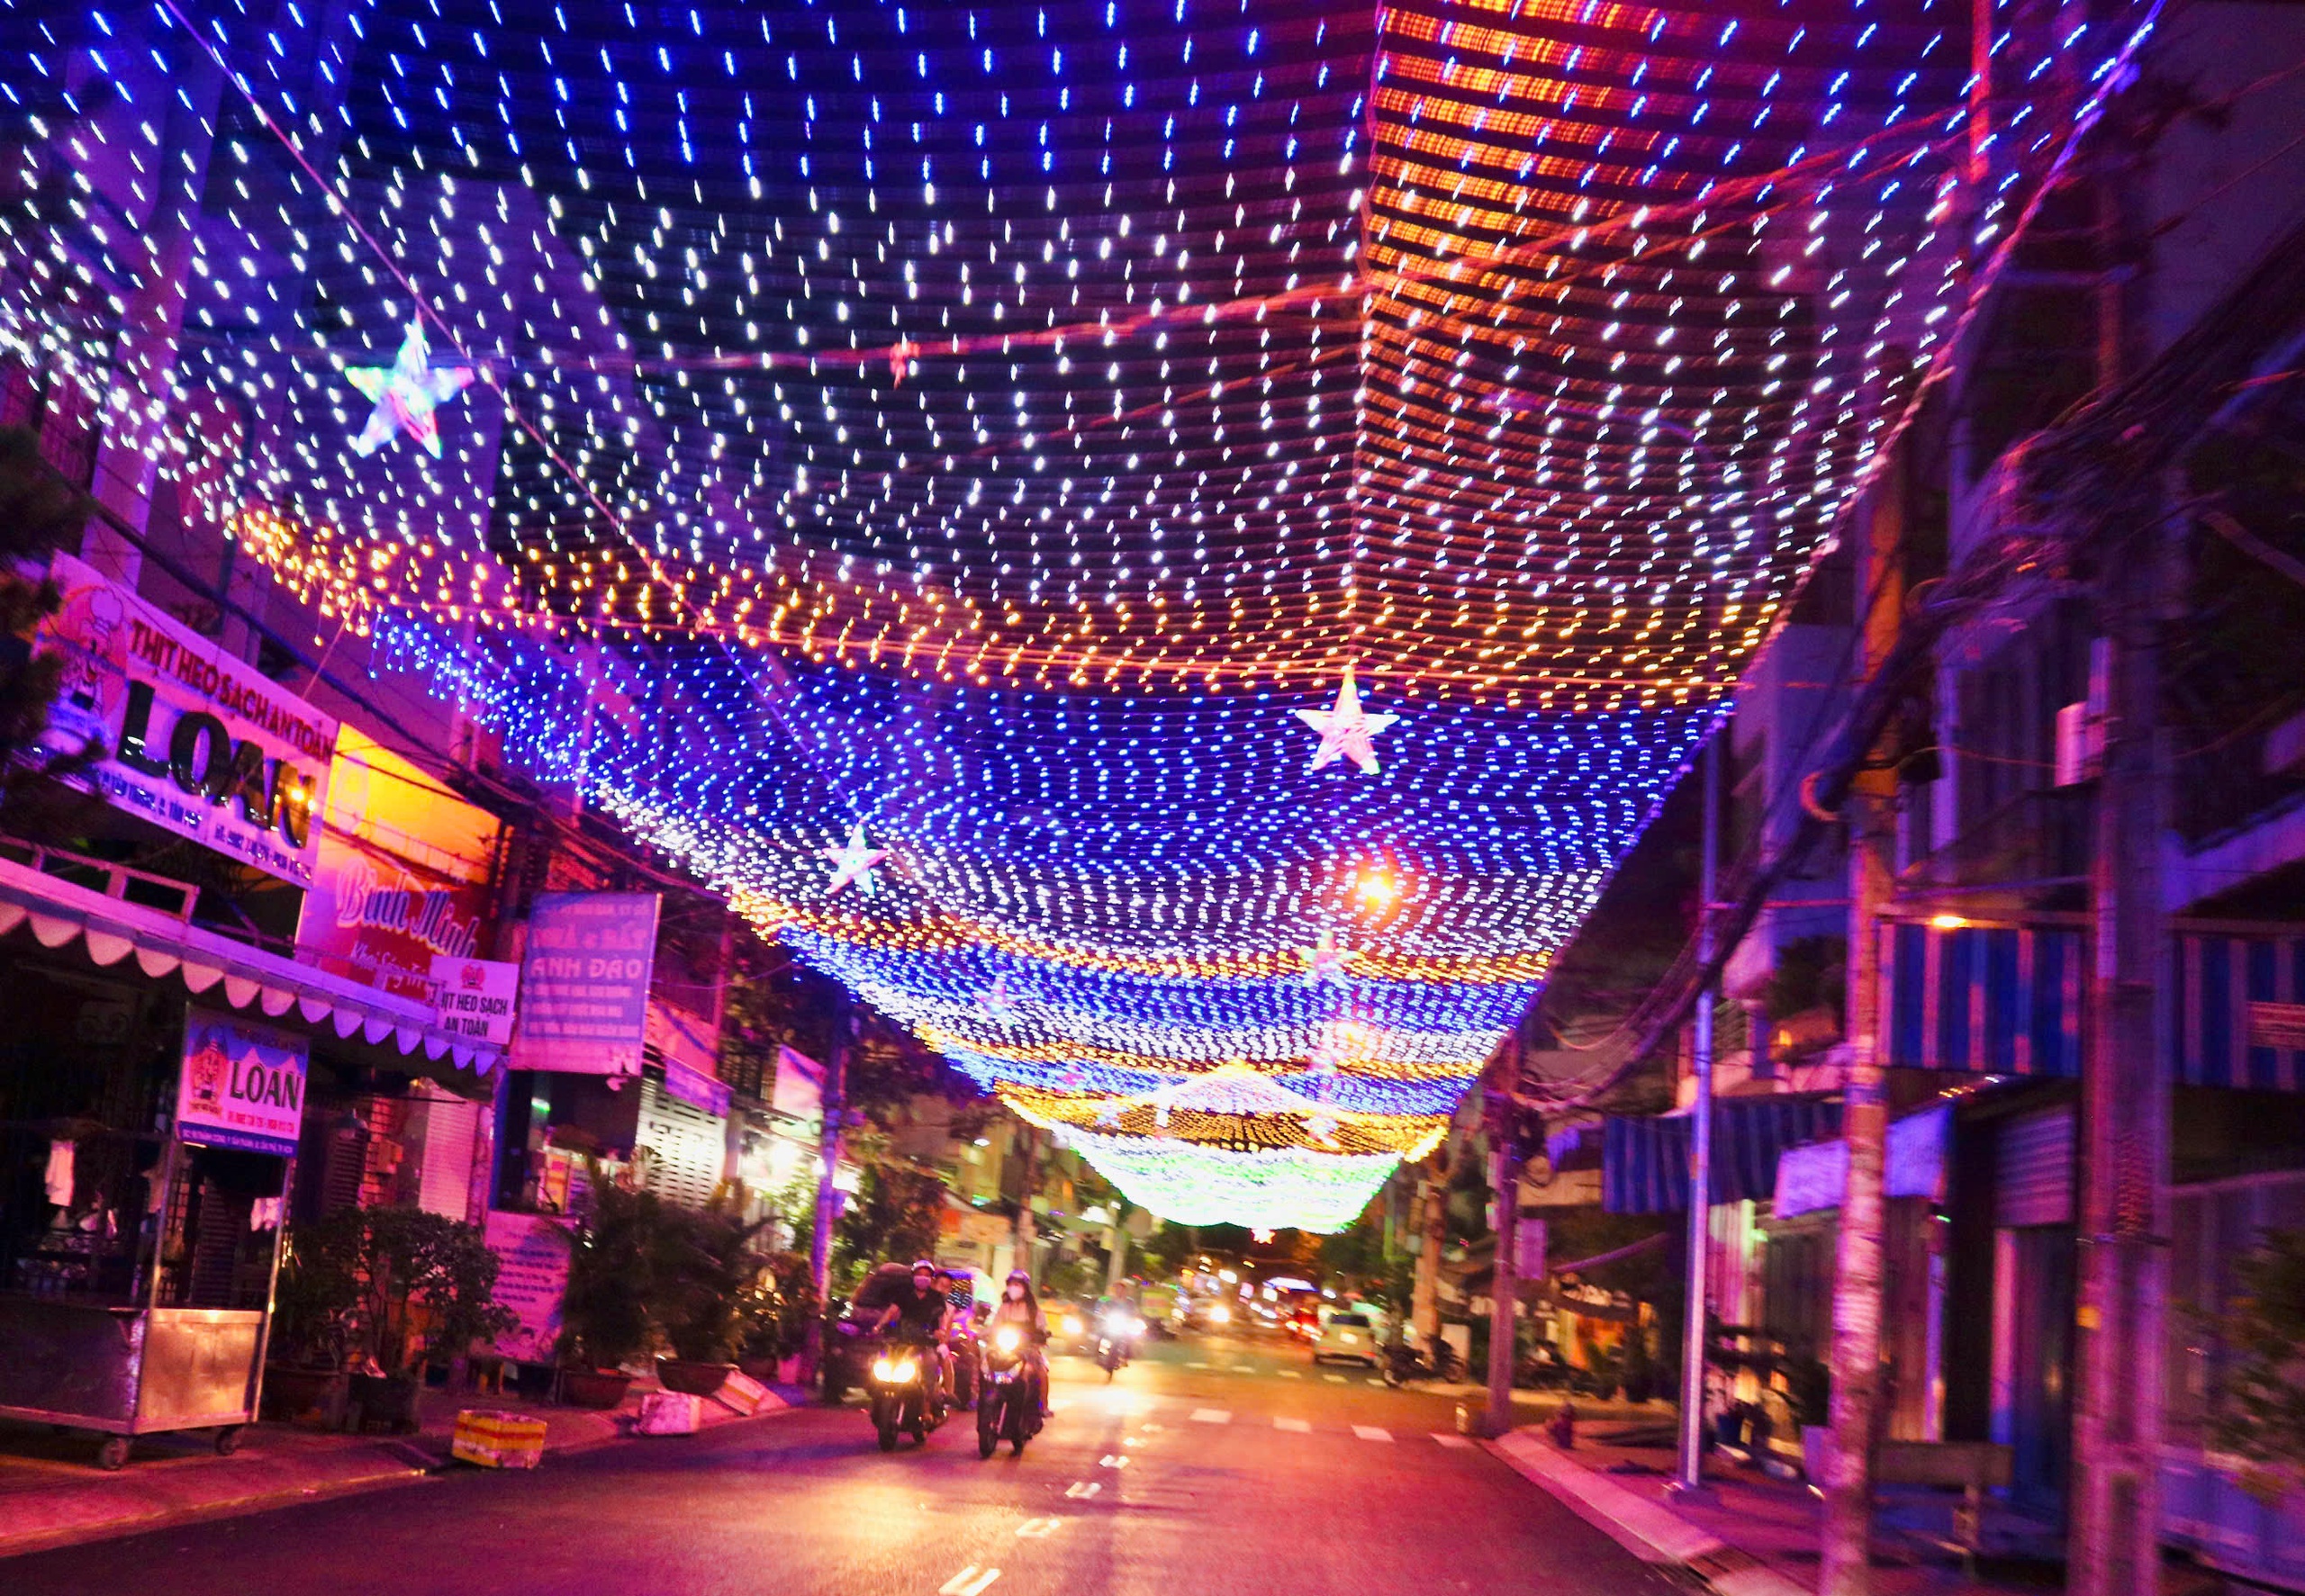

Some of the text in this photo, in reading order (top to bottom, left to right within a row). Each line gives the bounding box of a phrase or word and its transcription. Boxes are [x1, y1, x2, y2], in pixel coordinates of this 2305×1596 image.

[177, 647, 220, 696] HEO
[117, 680, 318, 849] LOAN
[410, 880, 480, 959] Minh
[444, 1016, 489, 1037] AN TOÀN
[456, 994, 478, 1012] HEO
[480, 996, 508, 1017] SẠCH
[230, 1061, 302, 1112] LOAN
